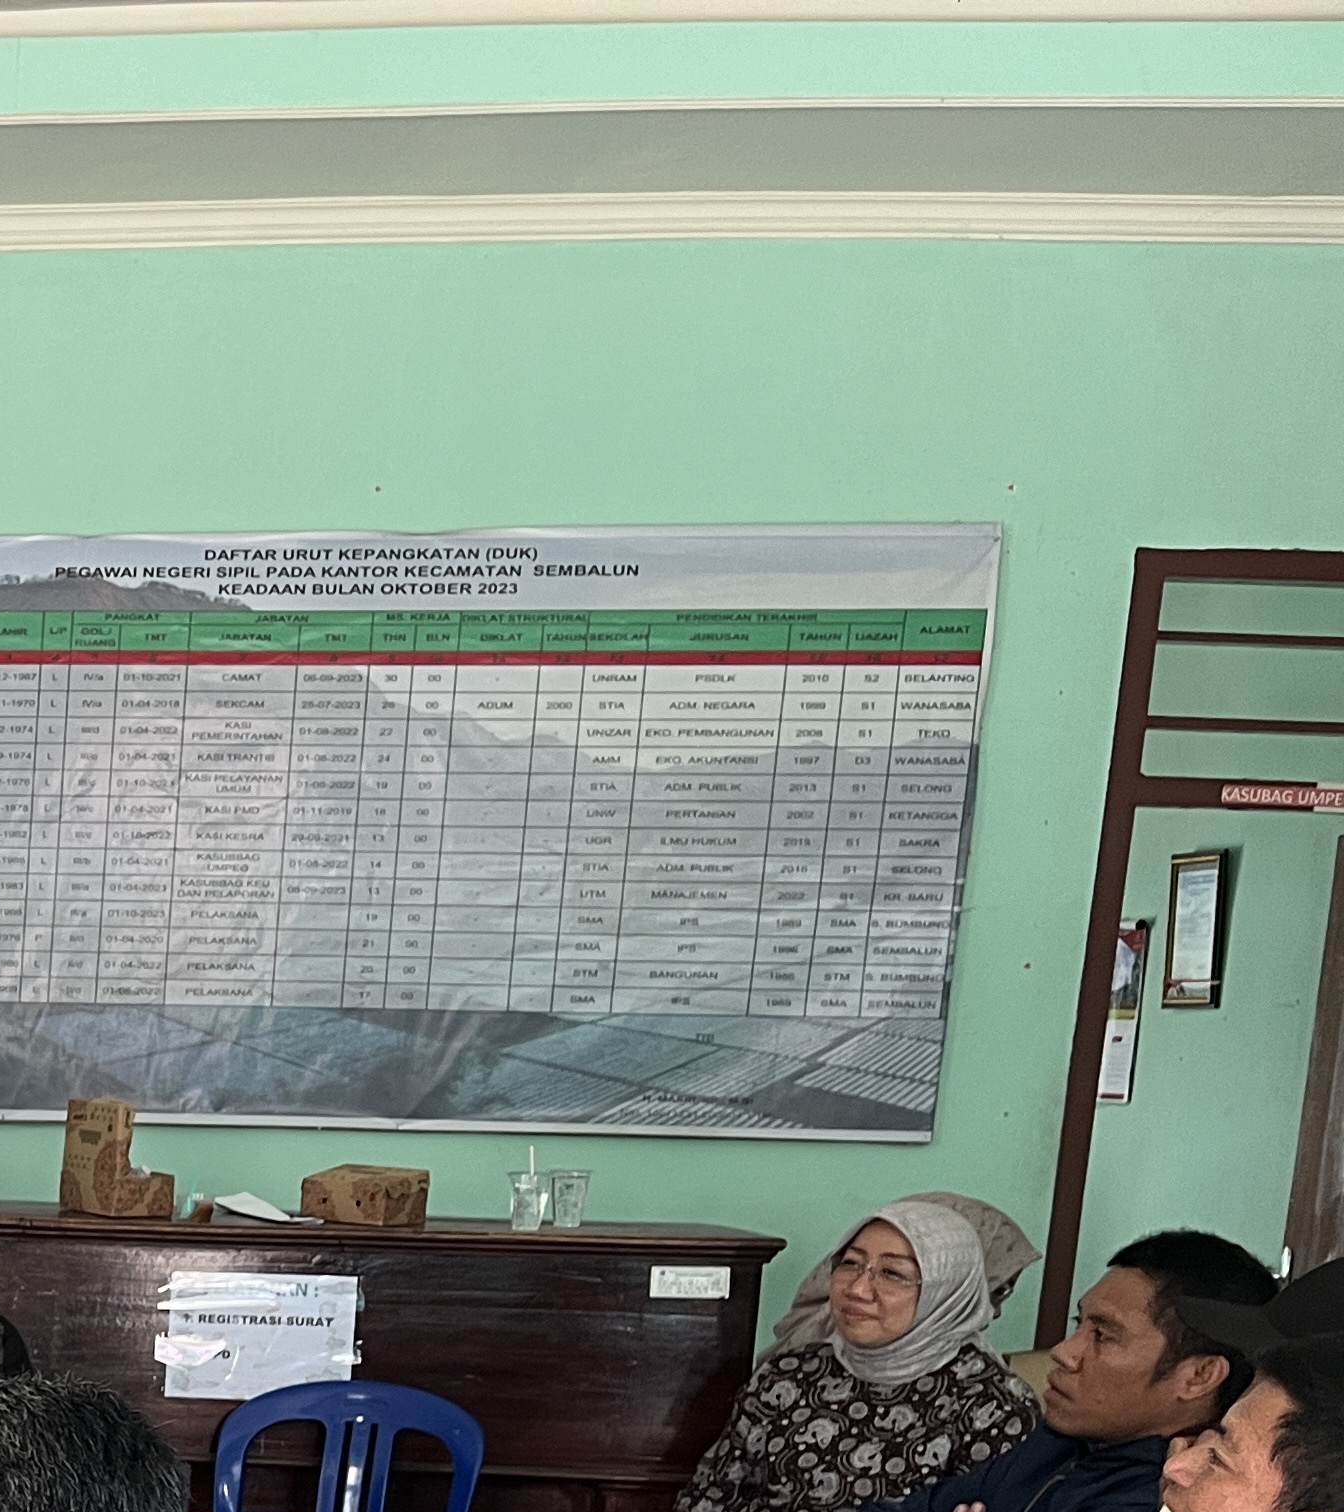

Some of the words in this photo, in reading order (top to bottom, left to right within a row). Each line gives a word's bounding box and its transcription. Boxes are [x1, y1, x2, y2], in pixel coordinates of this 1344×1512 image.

[204, 549, 276, 561] DAFTAR
[282, 549, 334, 561] URUT
[338, 548, 480, 560] KEPANGKATAN
[485, 547, 538, 562] (DUK)
[54, 566, 137, 578] PEGAWAI
[142, 566, 211, 578] NEGERI
[216, 566, 260, 578] SIPIL
[266, 566, 316, 578] PADA
[321, 566, 398, 578] KANTOR
[404, 565, 522, 577] KECAMATAN
[533, 564, 639, 577] SEMBALUN
[218, 583, 306, 595] KEADAAN
[312, 583, 374, 595] BULAN
[380, 583, 472, 595] OKTOBER
[478, 583, 518, 595] 2023
[919, 625, 971, 635] ALAMAT
[145, 633, 168, 642] TMT
[221, 673, 262, 682] CAMAT
[215, 700, 265, 709] SEKCAM
[477, 701, 514, 710] ADUM
[900, 702, 972, 711] WANASABA
[677, 729, 775, 738] PEMBANGUNAN
[918, 729, 951, 739] TEKO
[894, 757, 966, 765] WANASABA
[1221, 785, 1293, 804] KASUBAG
[665, 810, 736, 819] PERTANIAN
[190, 910, 260, 920] PELAKSANA
[188, 936, 258, 946] PELAKSANA
[186, 962, 256, 972] PELAKSANA
[184, 987, 254, 997] PELAKSANA
[198, 1313, 282, 1326] REGISTRASI
[286, 1316, 335, 1328] SURAT
